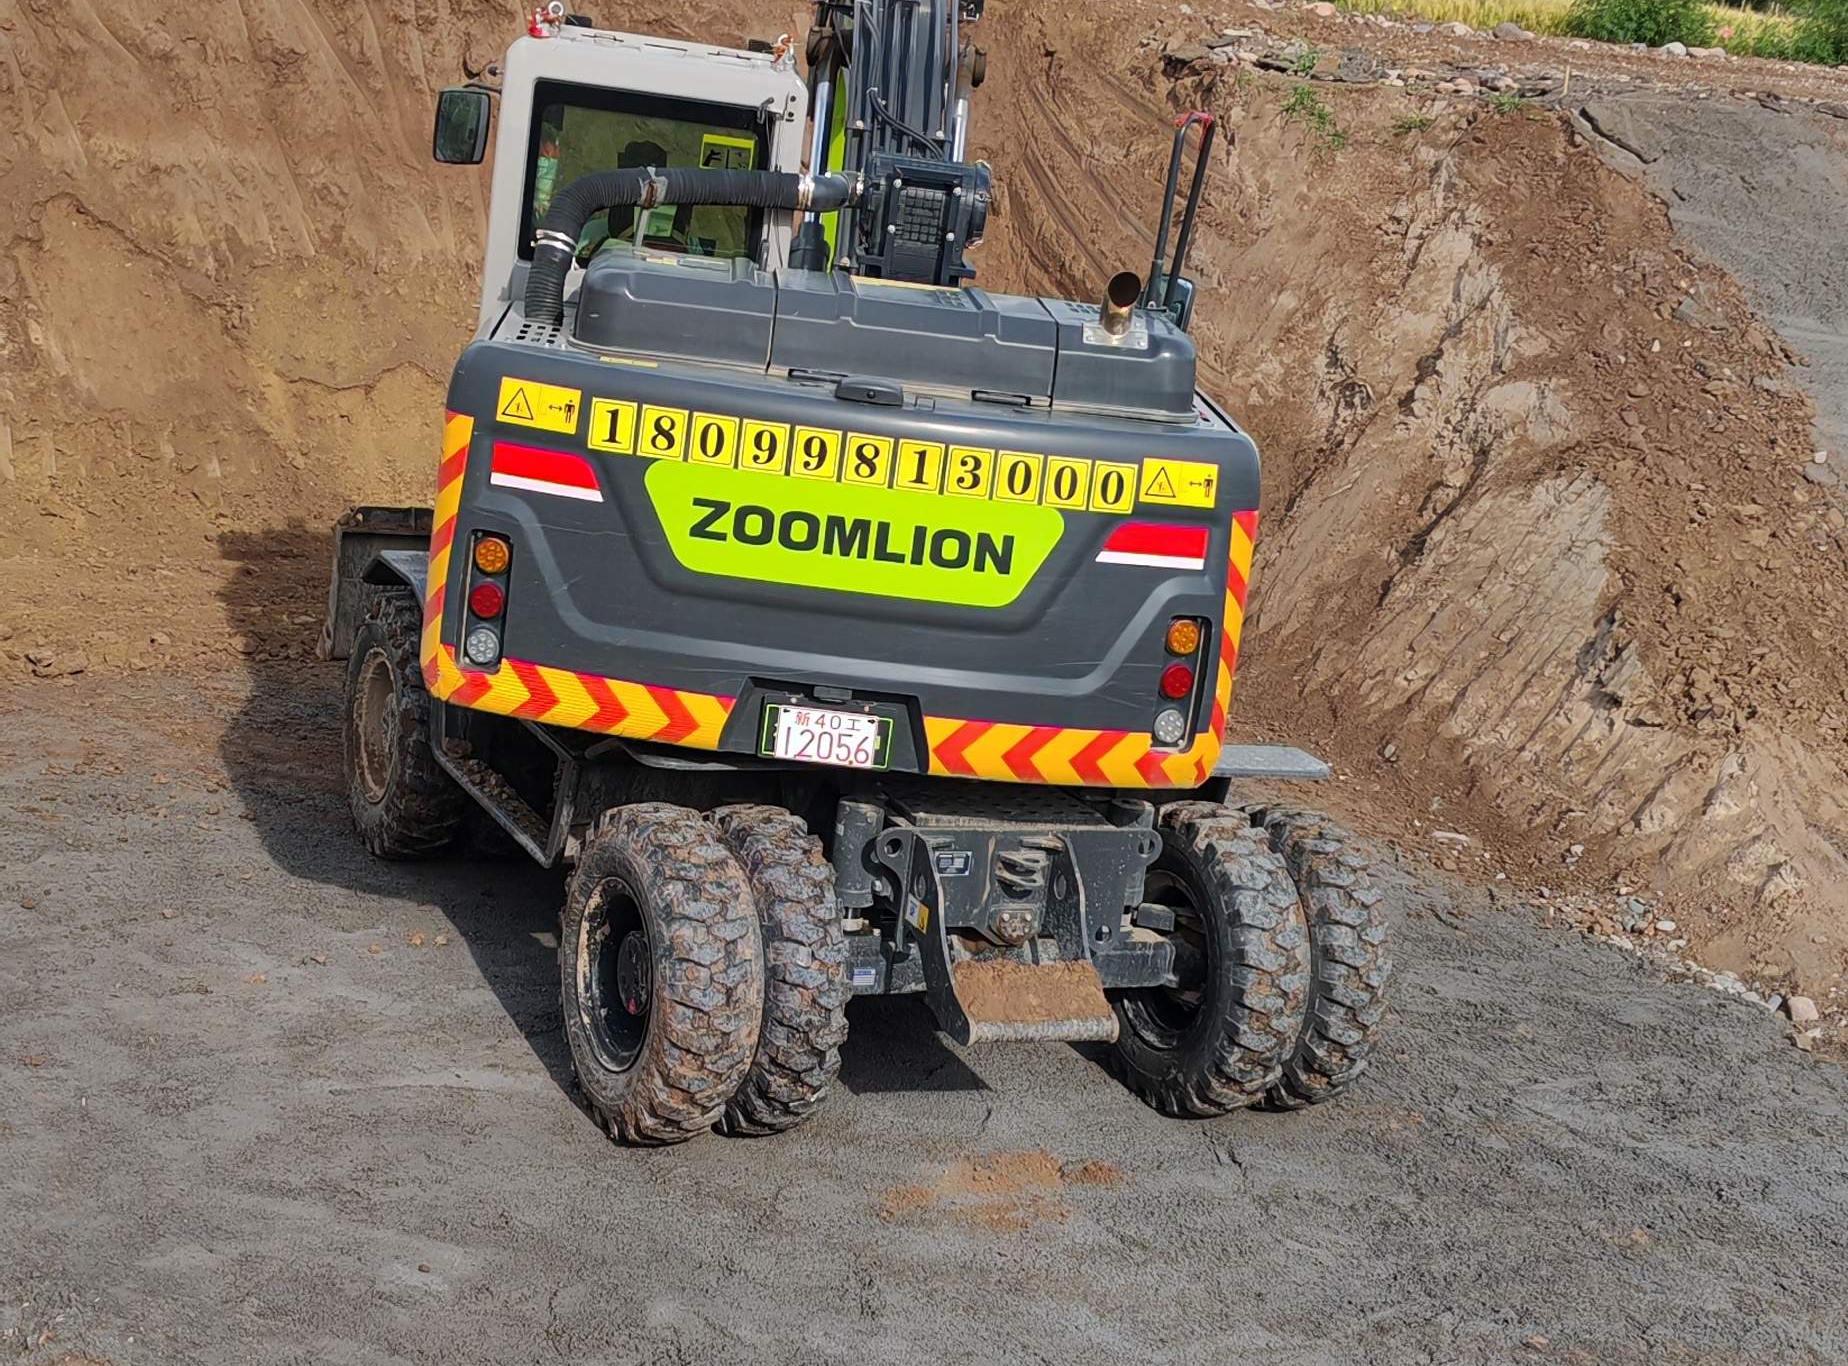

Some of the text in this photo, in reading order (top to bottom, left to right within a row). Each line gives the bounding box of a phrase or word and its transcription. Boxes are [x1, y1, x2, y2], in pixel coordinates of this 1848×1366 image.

[601, 408, 1124, 505] 18099813000
[689, 497, 1015, 575] ZOOMLION
[784, 726, 870, 764] 12056
